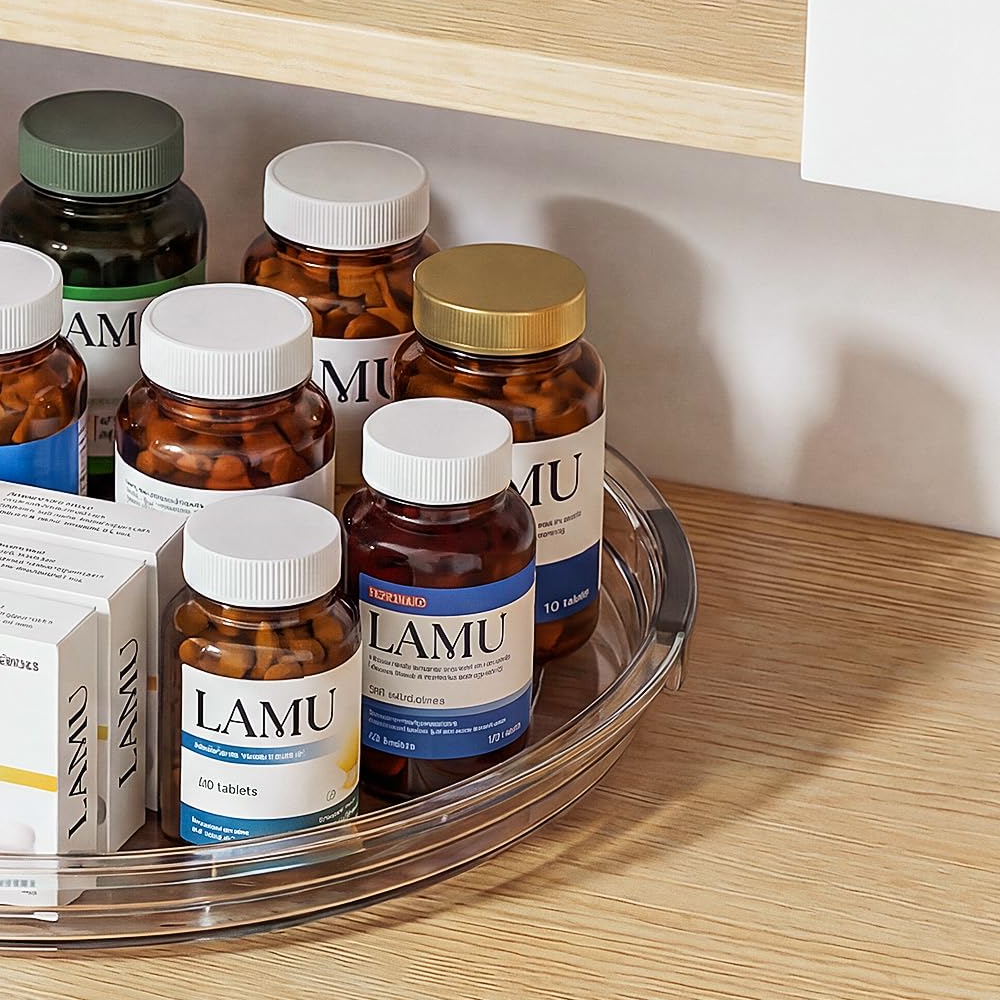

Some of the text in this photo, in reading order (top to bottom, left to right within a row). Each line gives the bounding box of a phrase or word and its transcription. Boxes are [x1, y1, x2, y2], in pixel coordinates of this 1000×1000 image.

[544, 601, 560, 614] 10
[369, 610, 507, 660] LAMU
[118, 638, 138, 788] LAMU
[195, 687, 337, 738] LAMU
[68, 685, 88, 839] LAMU
[217, 781, 258, 797] tablets
